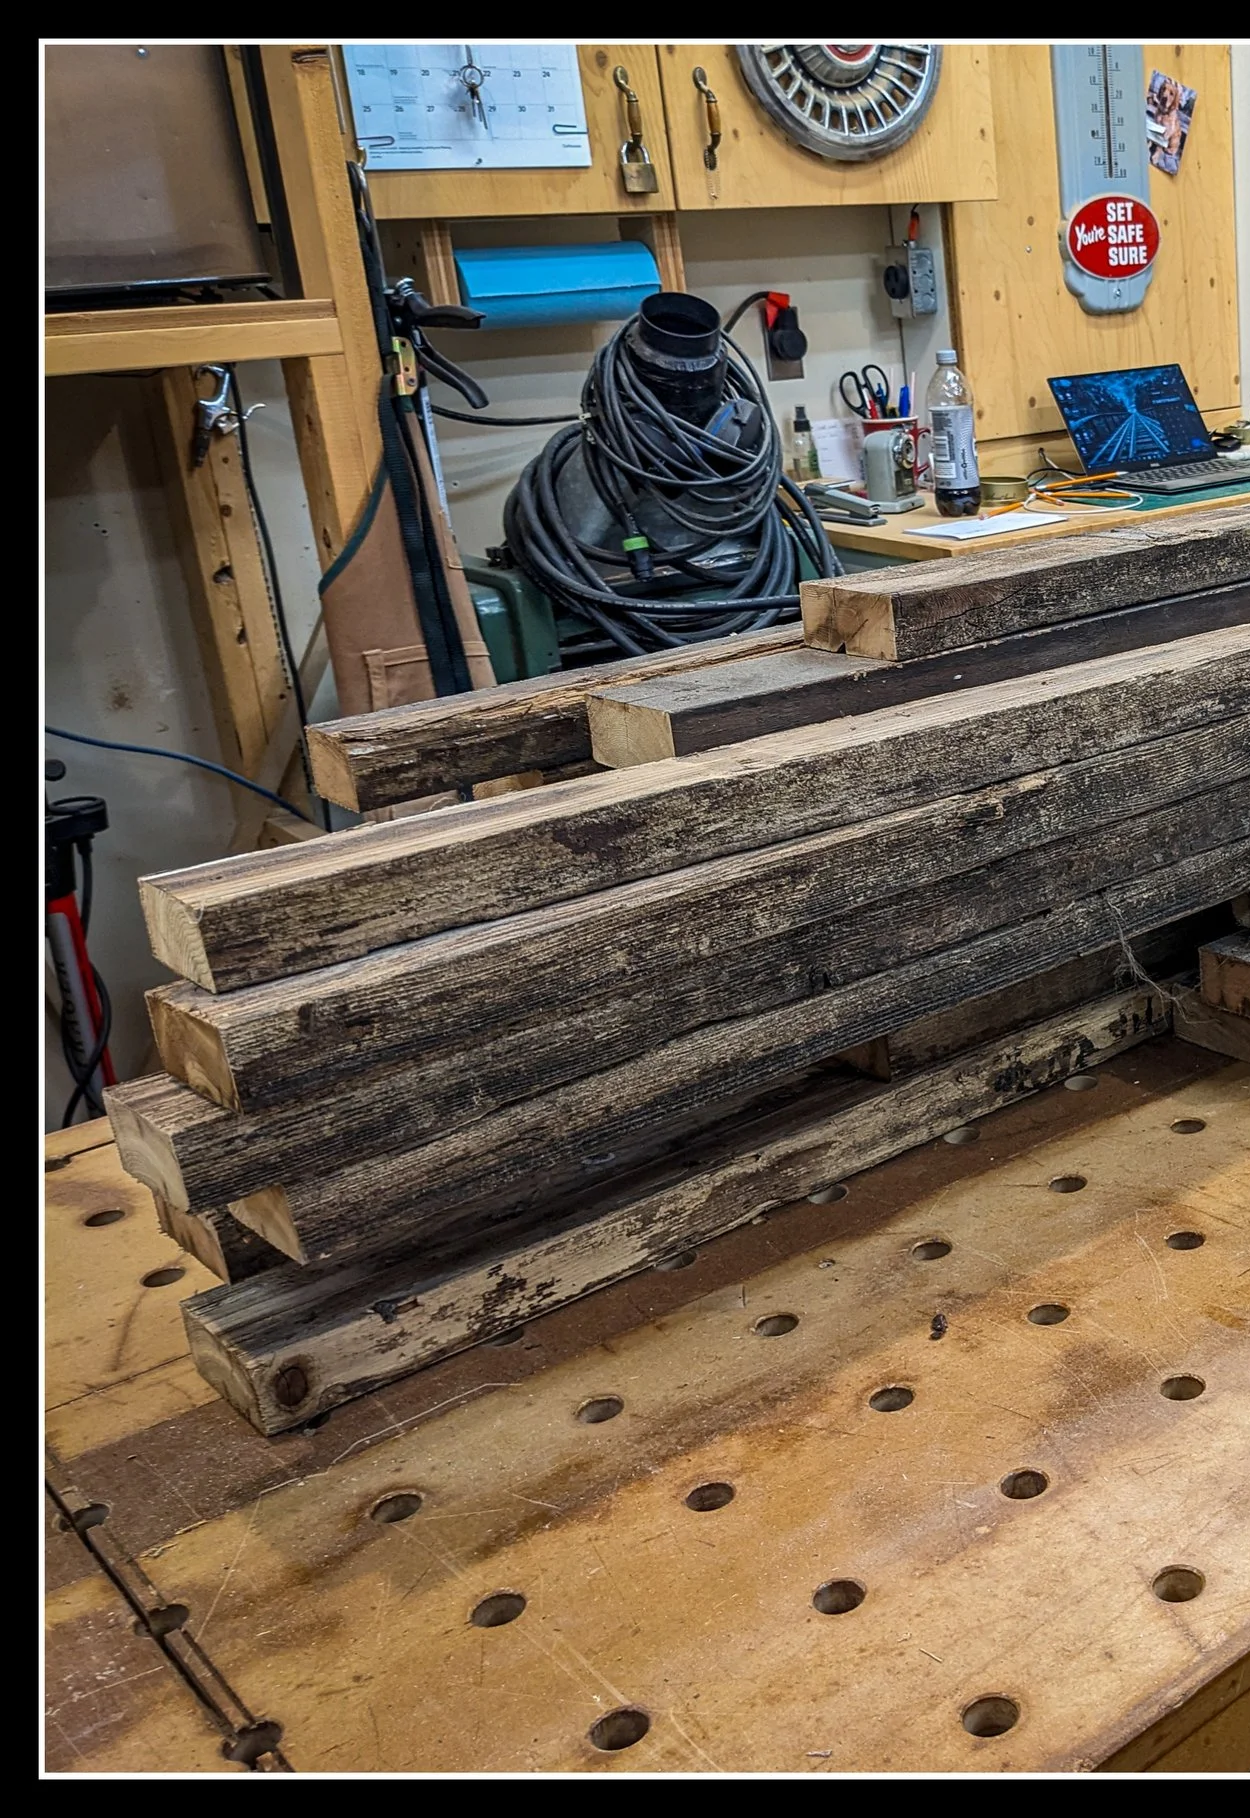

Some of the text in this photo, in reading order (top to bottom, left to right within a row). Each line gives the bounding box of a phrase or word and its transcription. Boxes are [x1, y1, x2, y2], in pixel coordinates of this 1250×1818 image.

[1106, 202, 1133, 222] SET
[1107, 224, 1144, 244] SAFE
[1108, 245, 1147, 266] SURE
